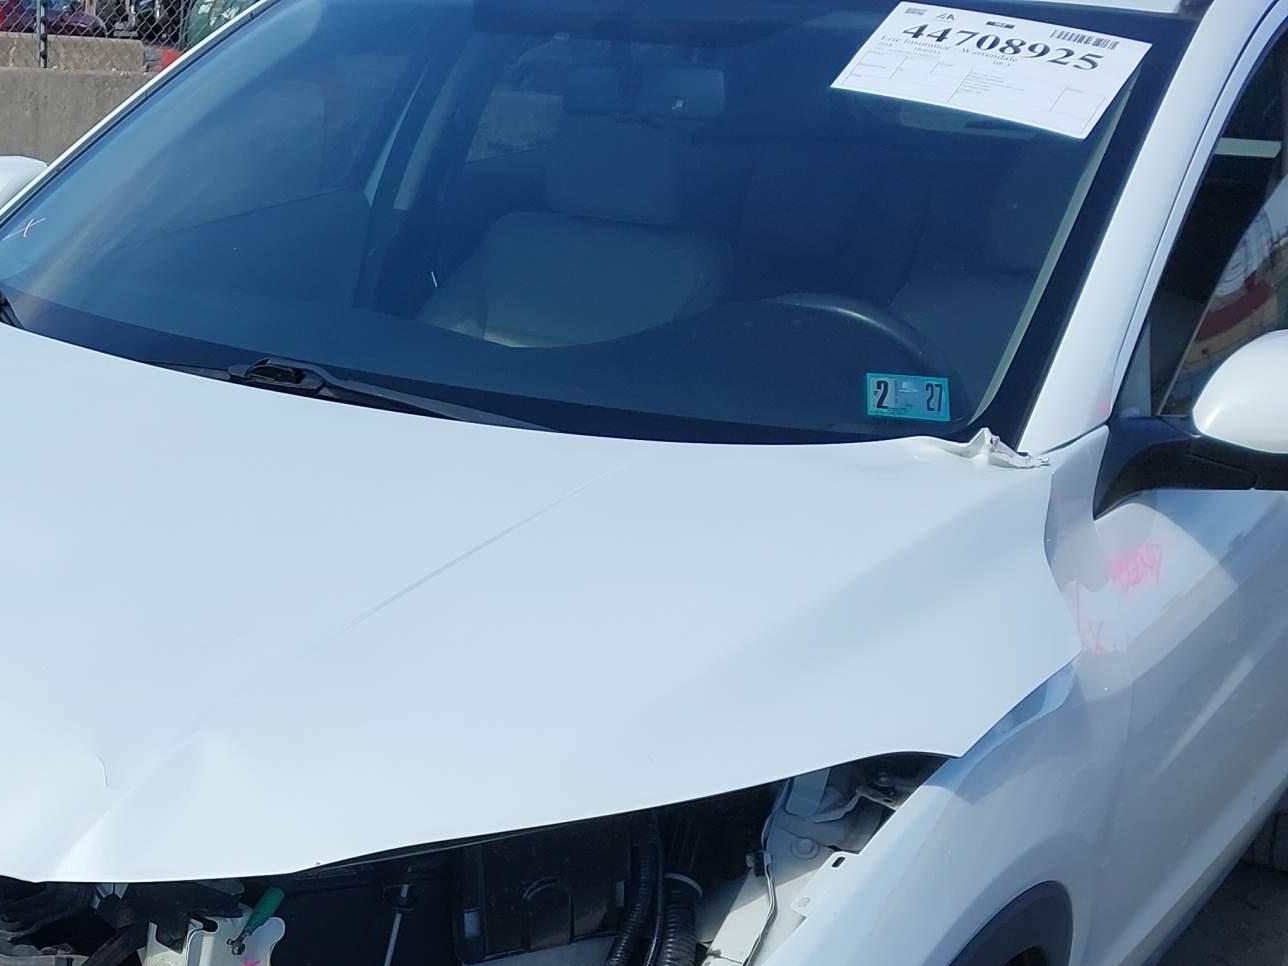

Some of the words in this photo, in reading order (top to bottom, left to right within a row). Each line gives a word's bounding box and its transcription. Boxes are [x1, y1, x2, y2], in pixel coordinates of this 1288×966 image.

[902, 24, 1104, 71] 44708925
[962, 47, 1018, 62] Warrendale
[876, 380, 889, 409] 2
[925, 383, 943, 412] 27
